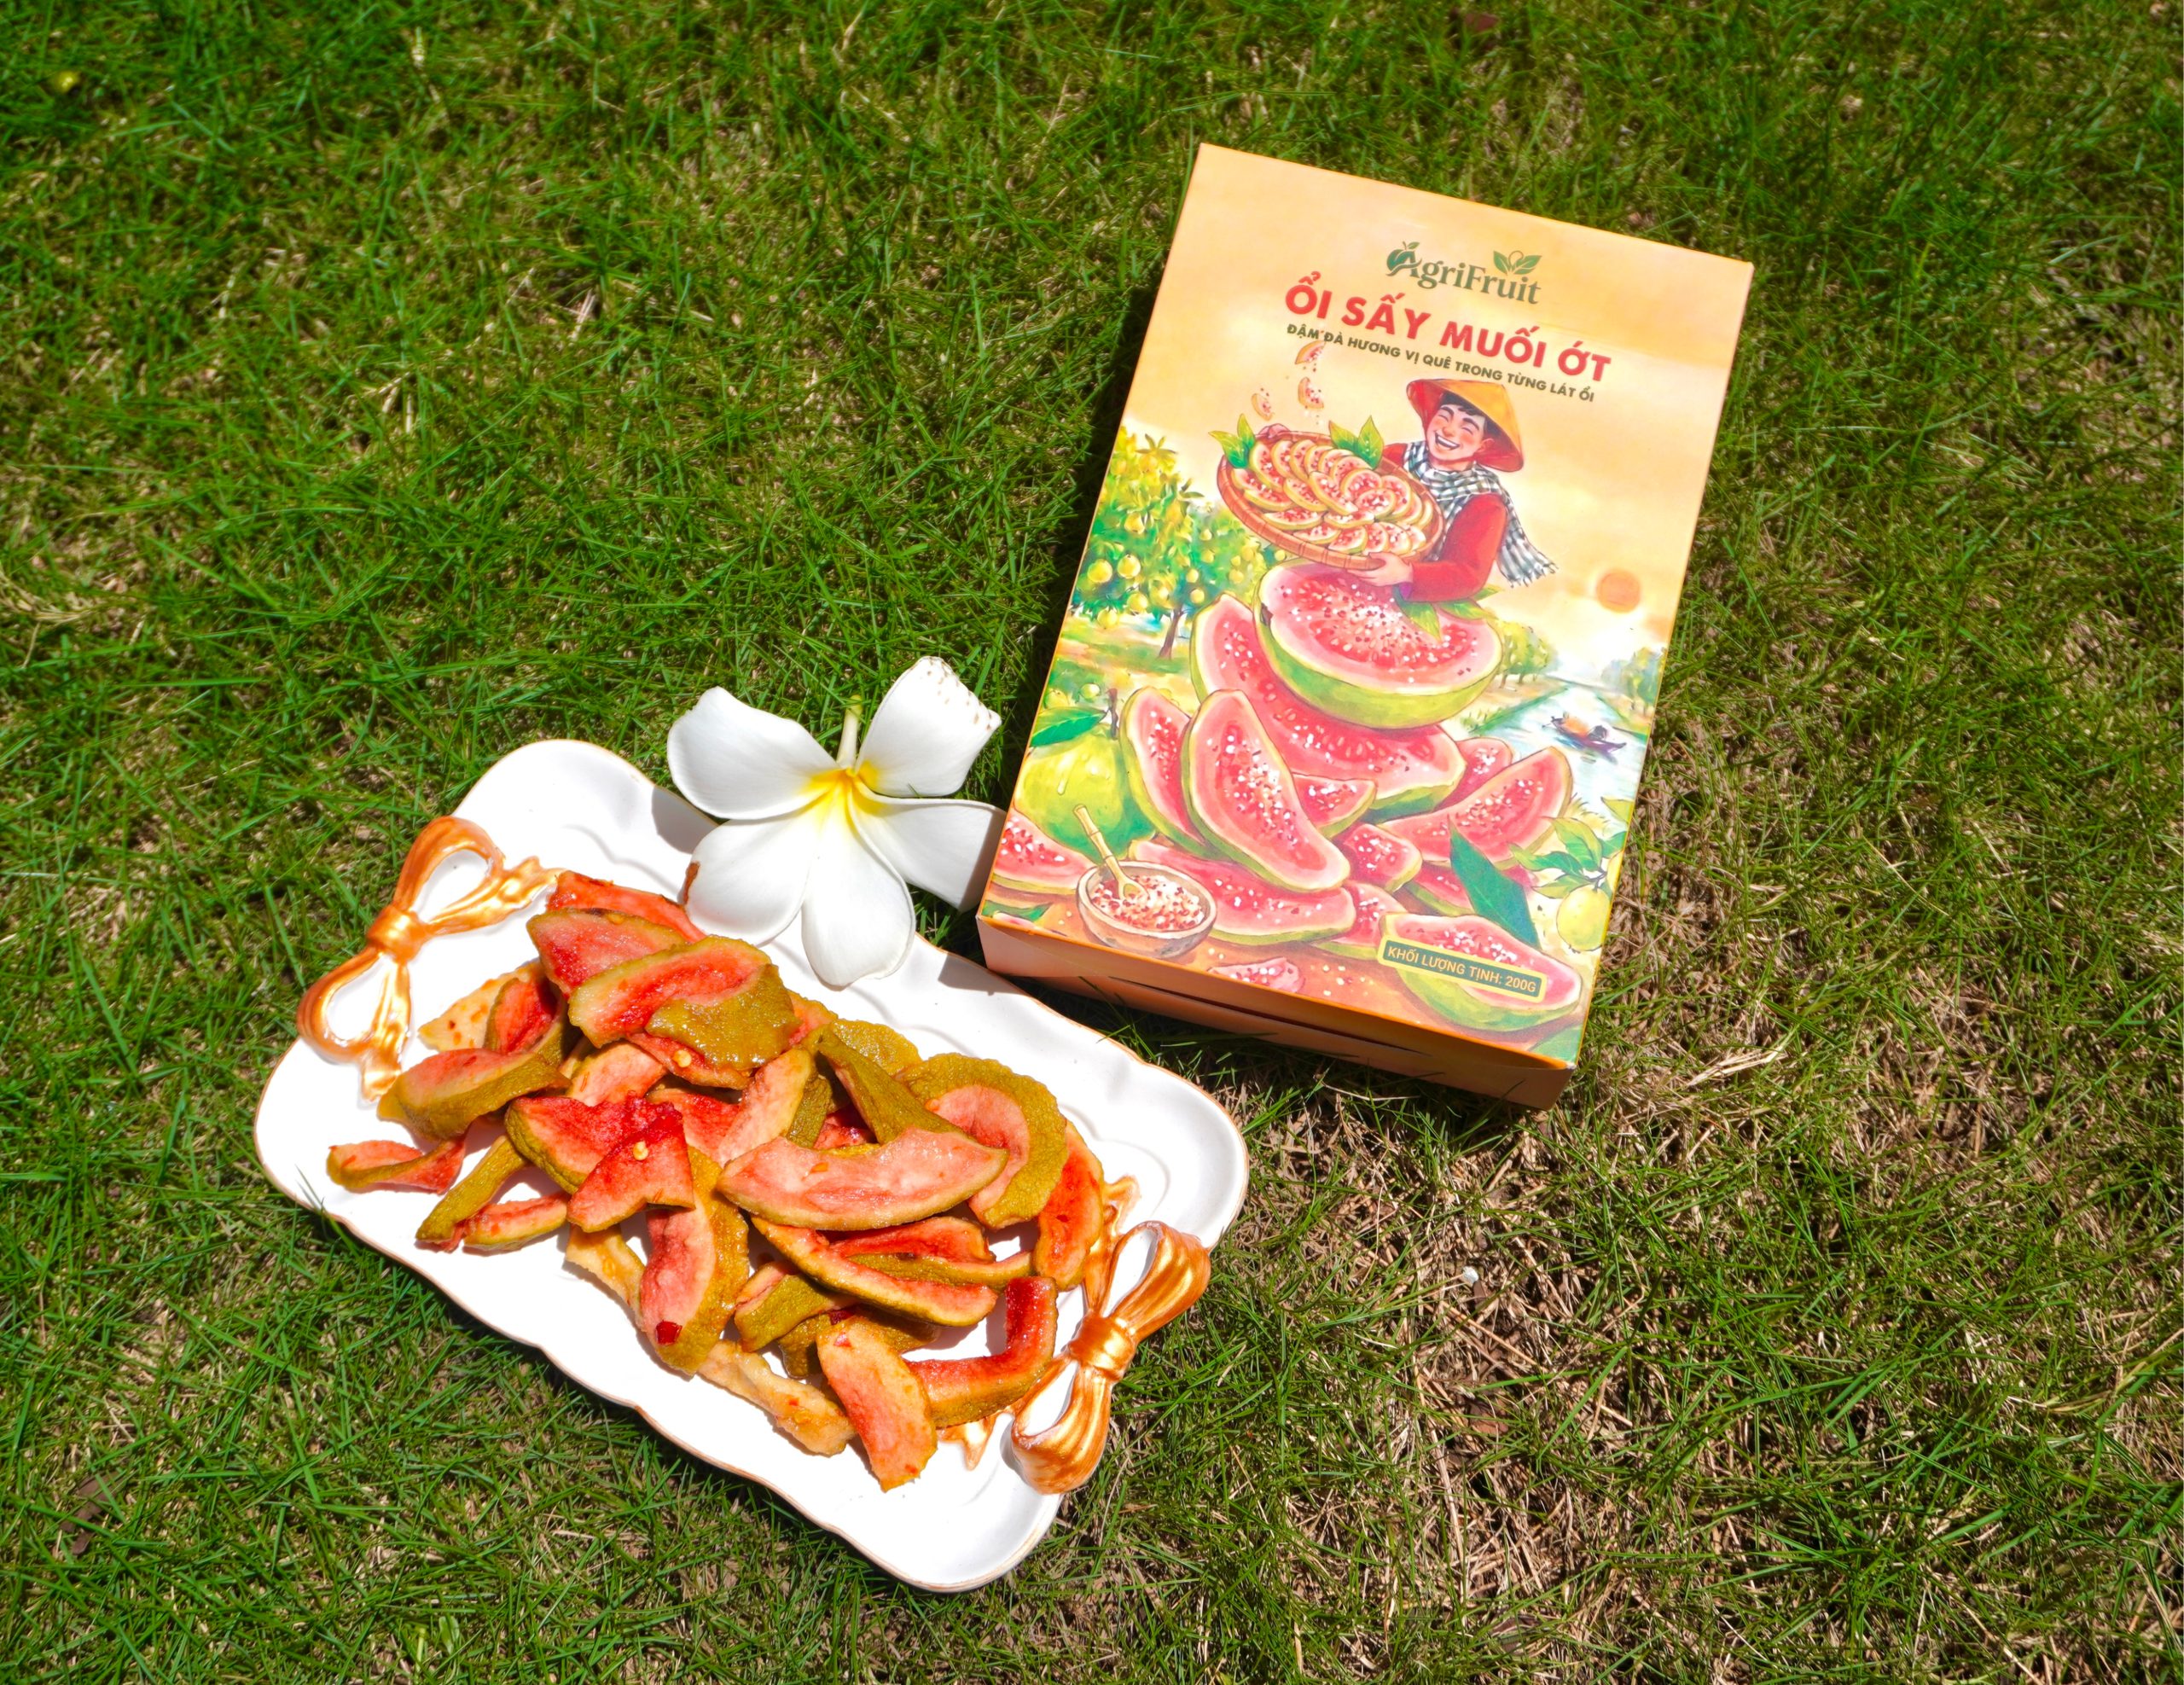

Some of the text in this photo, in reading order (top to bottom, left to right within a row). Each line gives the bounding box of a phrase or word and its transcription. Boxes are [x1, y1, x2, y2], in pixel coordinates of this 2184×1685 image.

[1385, 249, 1542, 305] AgriFruit
[1285, 270, 1612, 382] ỔI SẤY MUỐI ỚT
[1287, 323, 1594, 402] ĐẬM ĐÀ HƯƠNG VỊ QUÊ TRONG TỪNG LÁT ỔI
[1387, 945, 1536, 993] KHỐI LƯỢNG TỊNH: 200G
